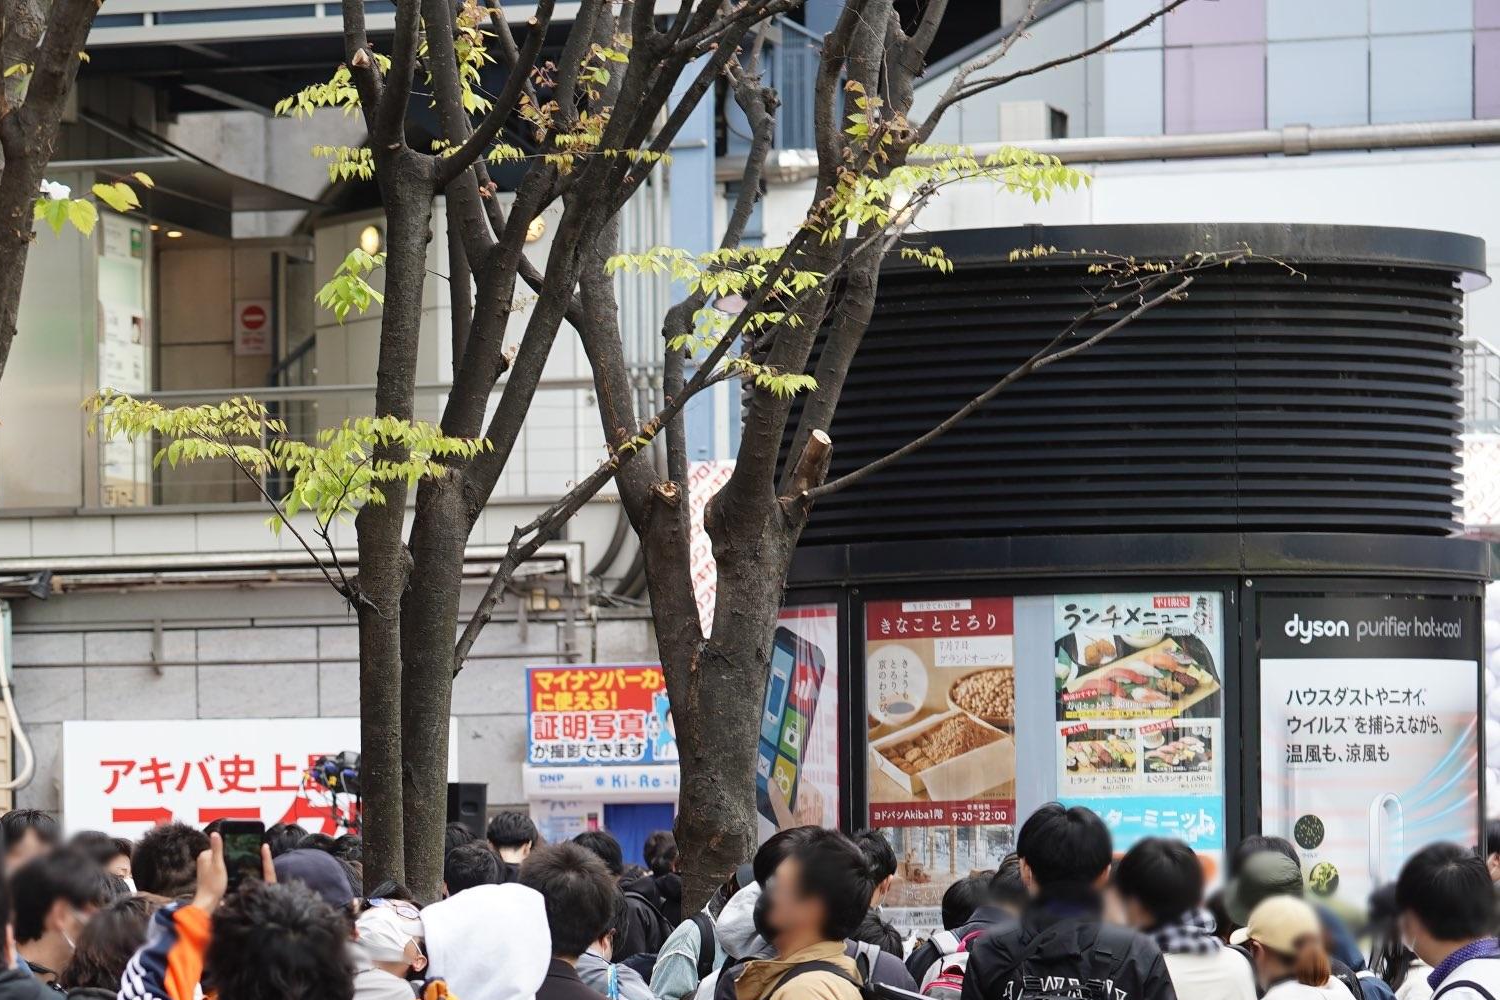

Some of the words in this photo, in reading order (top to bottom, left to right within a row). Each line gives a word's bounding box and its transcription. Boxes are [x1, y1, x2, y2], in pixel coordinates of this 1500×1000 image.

[880, 613, 997, 635] きなこととろり
[1064, 603, 1189, 631] ランチメニュー
[1284, 613, 1350, 644] dyson
[1356, 616, 1412, 642] purifier
[1414, 615, 1462, 639] hot+cool
[534, 669, 665, 690] マイナンバーカ
[536, 690, 618, 711] に使える!
[535, 713, 645, 740] 証明写真
[534, 742, 645, 760] が撮影できます
[1286, 743, 1390, 764] 温風も、涼風も
[540, 774, 564, 783] DNP
[874, 808, 943, 821] ヨドバシAkiba1階
[967, 803, 991, 811] 営業時間
[1098, 808, 1211, 836] ターミニット
